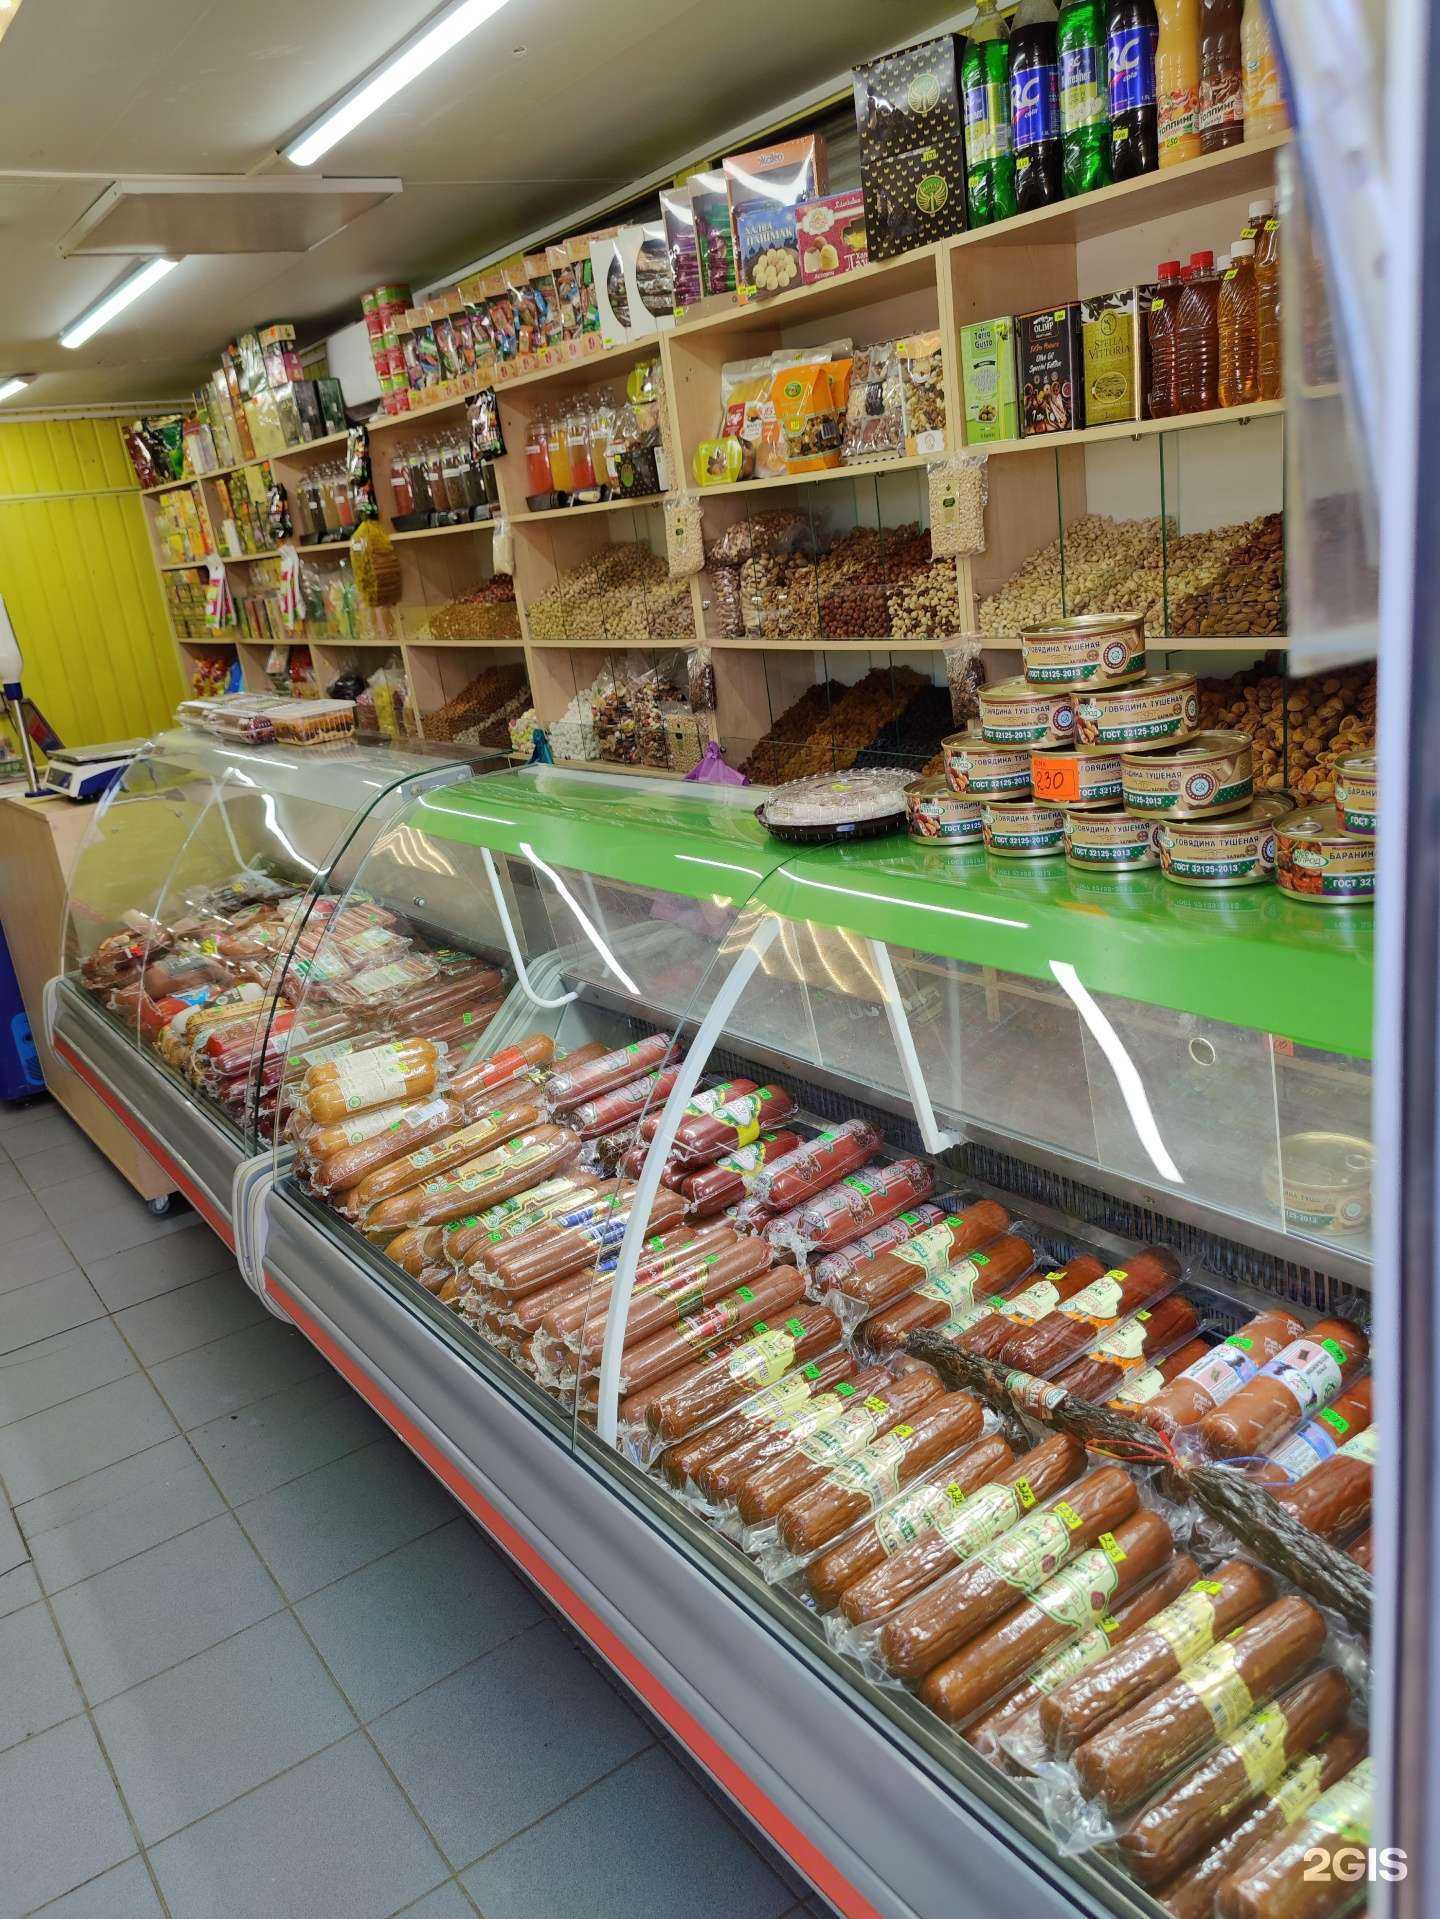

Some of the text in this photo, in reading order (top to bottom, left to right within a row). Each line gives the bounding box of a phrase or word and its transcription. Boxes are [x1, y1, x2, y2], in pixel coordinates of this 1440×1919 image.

[1158, 113, 1194, 133] ТОППИНГ
[1034, 321, 1054, 332] OLIMP
[1063, 641, 1100, 652] ТУШЕНАЯ
[1041, 669, 1081, 678] 32125-2013
[1104, 702, 1148, 713] ГОВЯДИНА
[1150, 695, 1183, 708] ТУШЕНАЯ
[1015, 705, 1050, 715] ТУШЕНАЯ
[995, 731, 1032, 739] 32125-2013
[1102, 725, 1168, 739] ГОСТ 32125-2013
[974, 757, 1012, 766] ГОВЯДИНА
[1014, 754, 1030, 764] ТУШ
[1081, 760, 1121, 772] ГОВЯДИНА
[972, 775, 1030, 788] ГОСТ 32125-2013
[1036, 771, 1064, 791] 230
[1146, 772, 1182, 780] ТУШЕНАЯ
[1079, 786, 1121, 797] ГОСТ 32125
[1348, 788, 1376, 796] БАРАНИ
[996, 812, 1062, 823] ГОВЯДИНА ТУШЕНА
[1350, 816, 1369, 826] ГОСТ
[944, 821, 982, 832] ГОСТ 32125
[1075, 823, 1150, 834] ГОВЯДИНА ТУШЕНАЯ
[994, 836, 1049, 844] ГОСТ 32125-2013
[1175, 836, 1259, 848] ГОВЯДИНА ТУШЕНАЯ
[1074, 848, 1131, 857] ГОСТ 32125-2013
[1329, 850, 1374, 860] БАРАНИН
[1174, 863, 1238, 873] ГОСТ 32125-2013
[1333, 878, 1356, 888] ГОСТ
